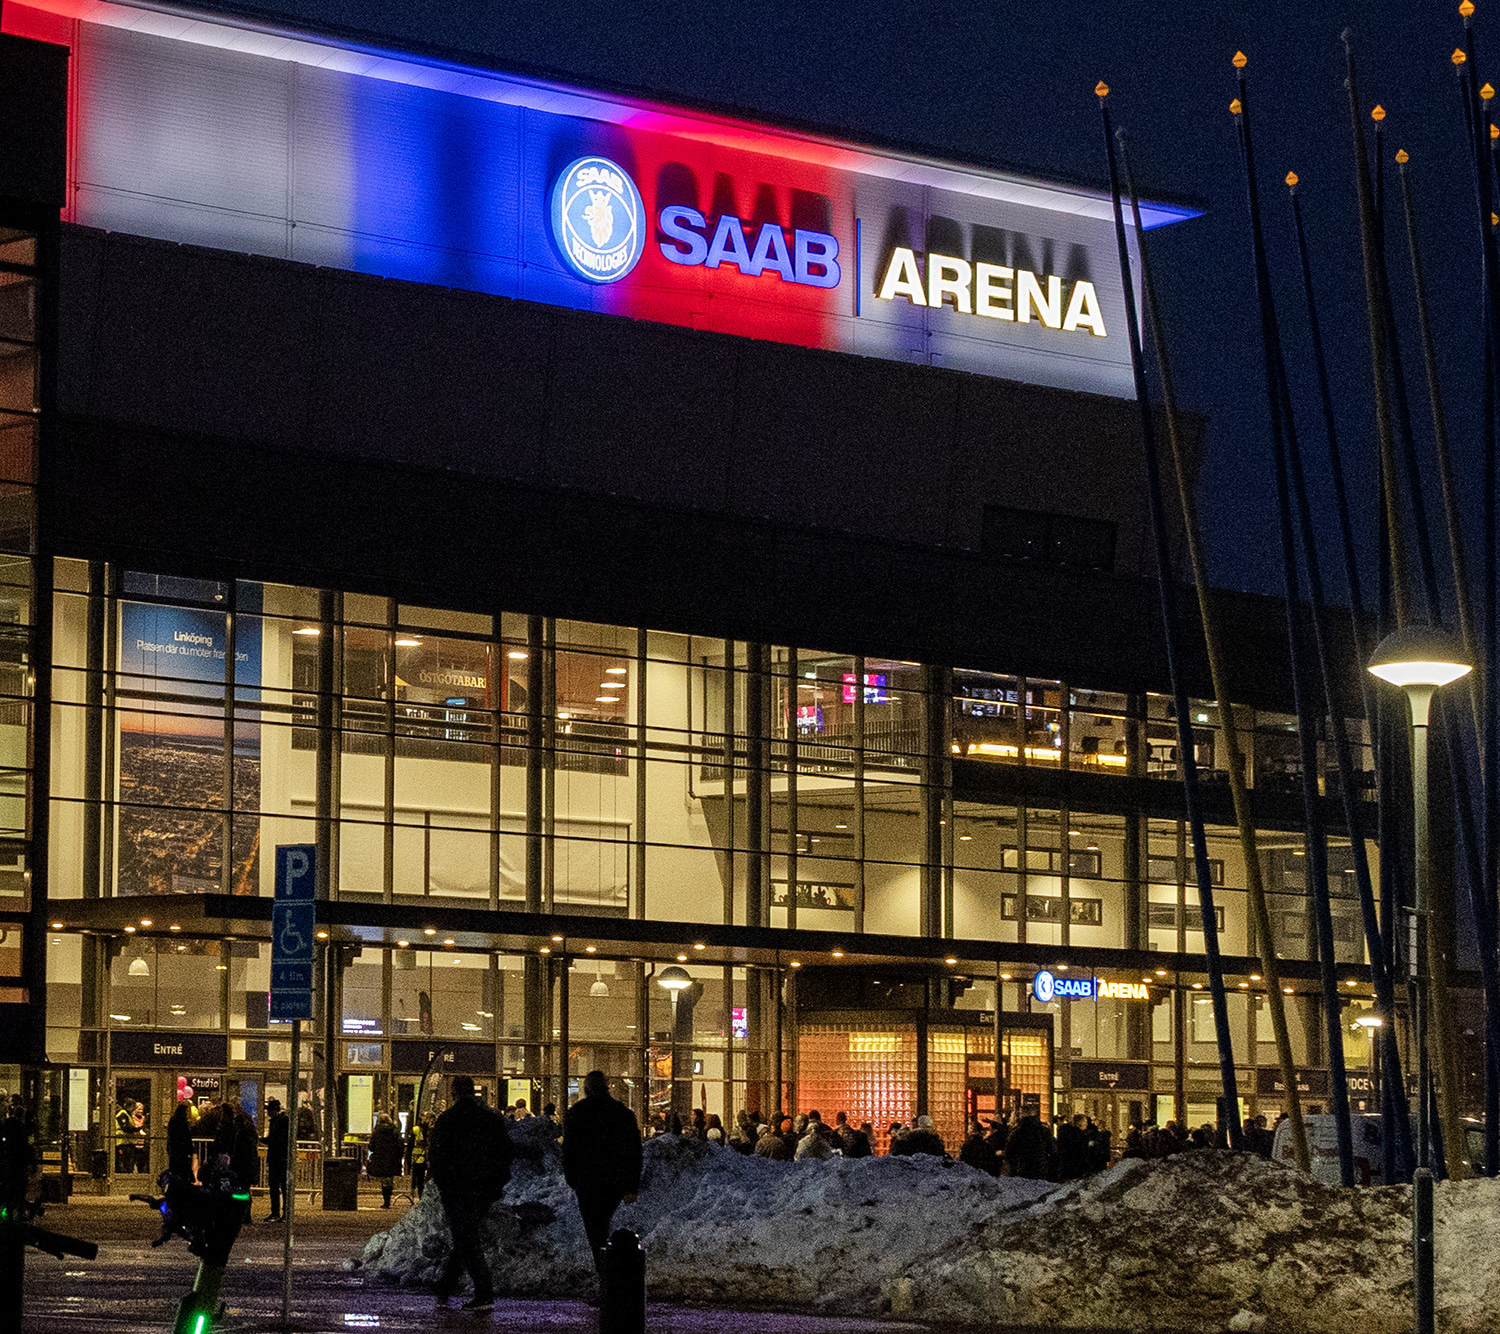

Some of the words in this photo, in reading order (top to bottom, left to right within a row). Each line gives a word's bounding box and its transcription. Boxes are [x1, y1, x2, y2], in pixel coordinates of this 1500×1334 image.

[575, 167, 624, 194] SAAB
[658, 204, 842, 289] SAAB
[876, 246, 1108, 337] ARENA
[173, 631, 213, 647] Linköping
[285, 850, 310, 897] P
[1053, 979, 1092, 997] SAAB
[1097, 982, 1150, 1000] ARENA
[191, 1077, 219, 1089] Studio
